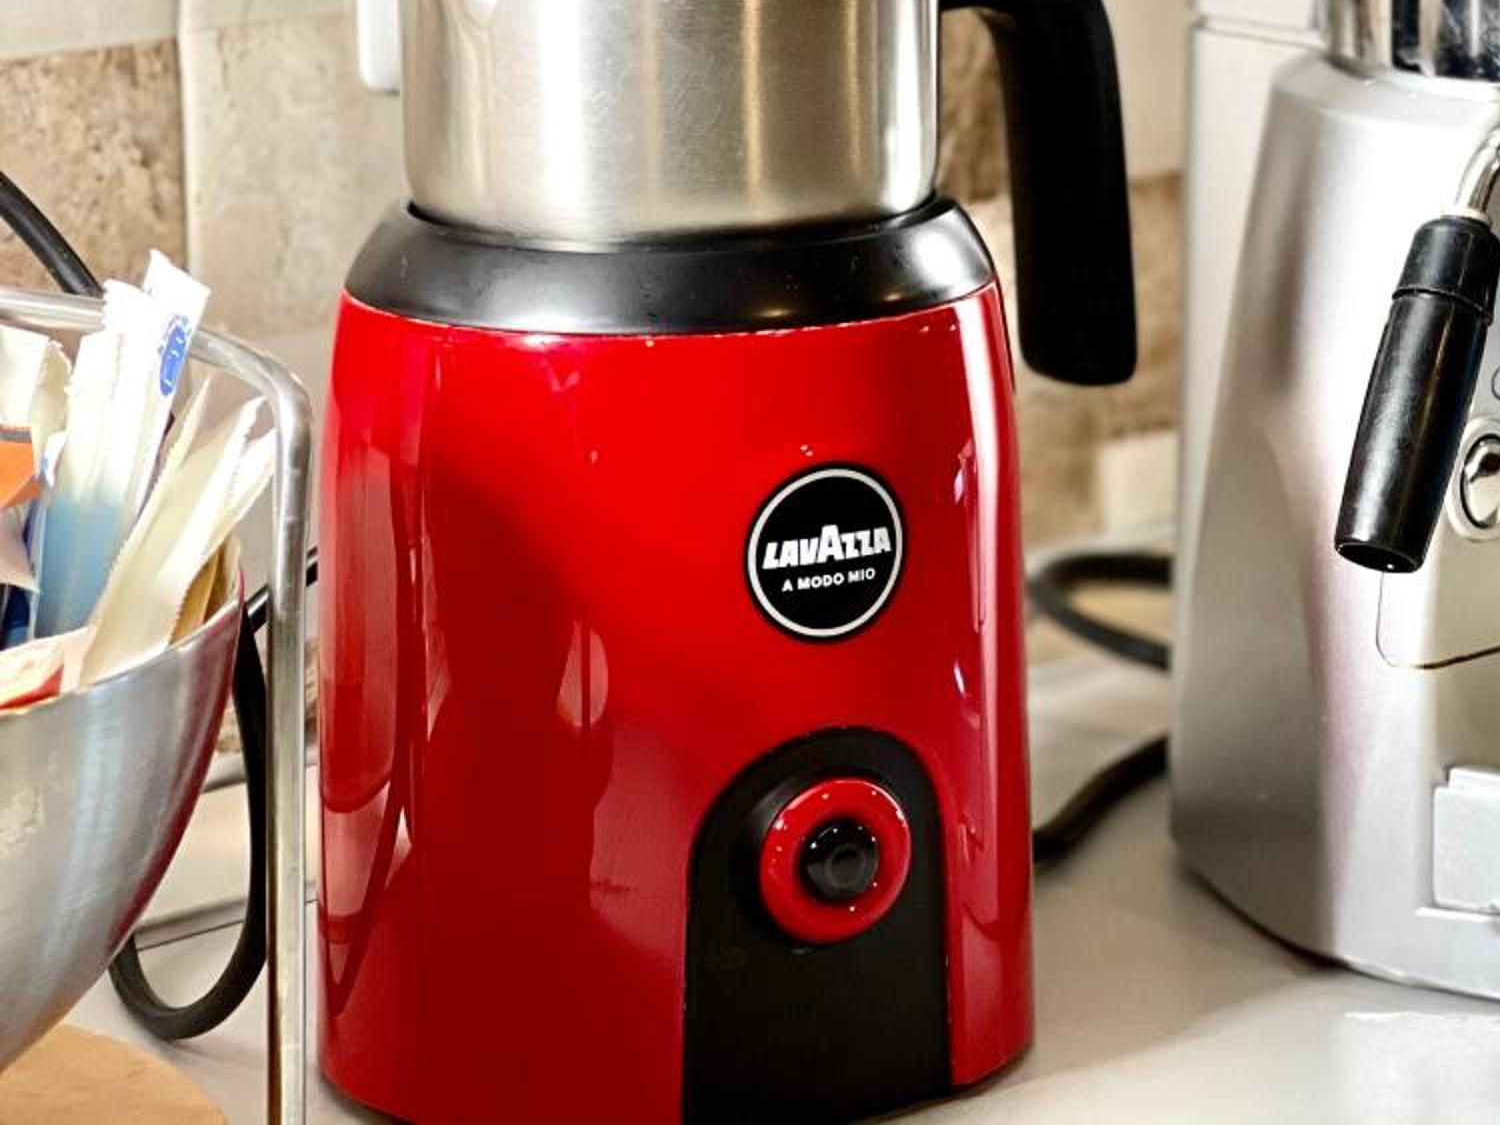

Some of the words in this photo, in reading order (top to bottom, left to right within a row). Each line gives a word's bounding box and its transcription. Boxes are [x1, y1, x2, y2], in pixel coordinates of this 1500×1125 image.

[762, 525, 892, 569] LAVAZZA
[782, 579, 794, 592] A
[797, 573, 845, 590] MODO
[848, 568, 876, 582] MIO
